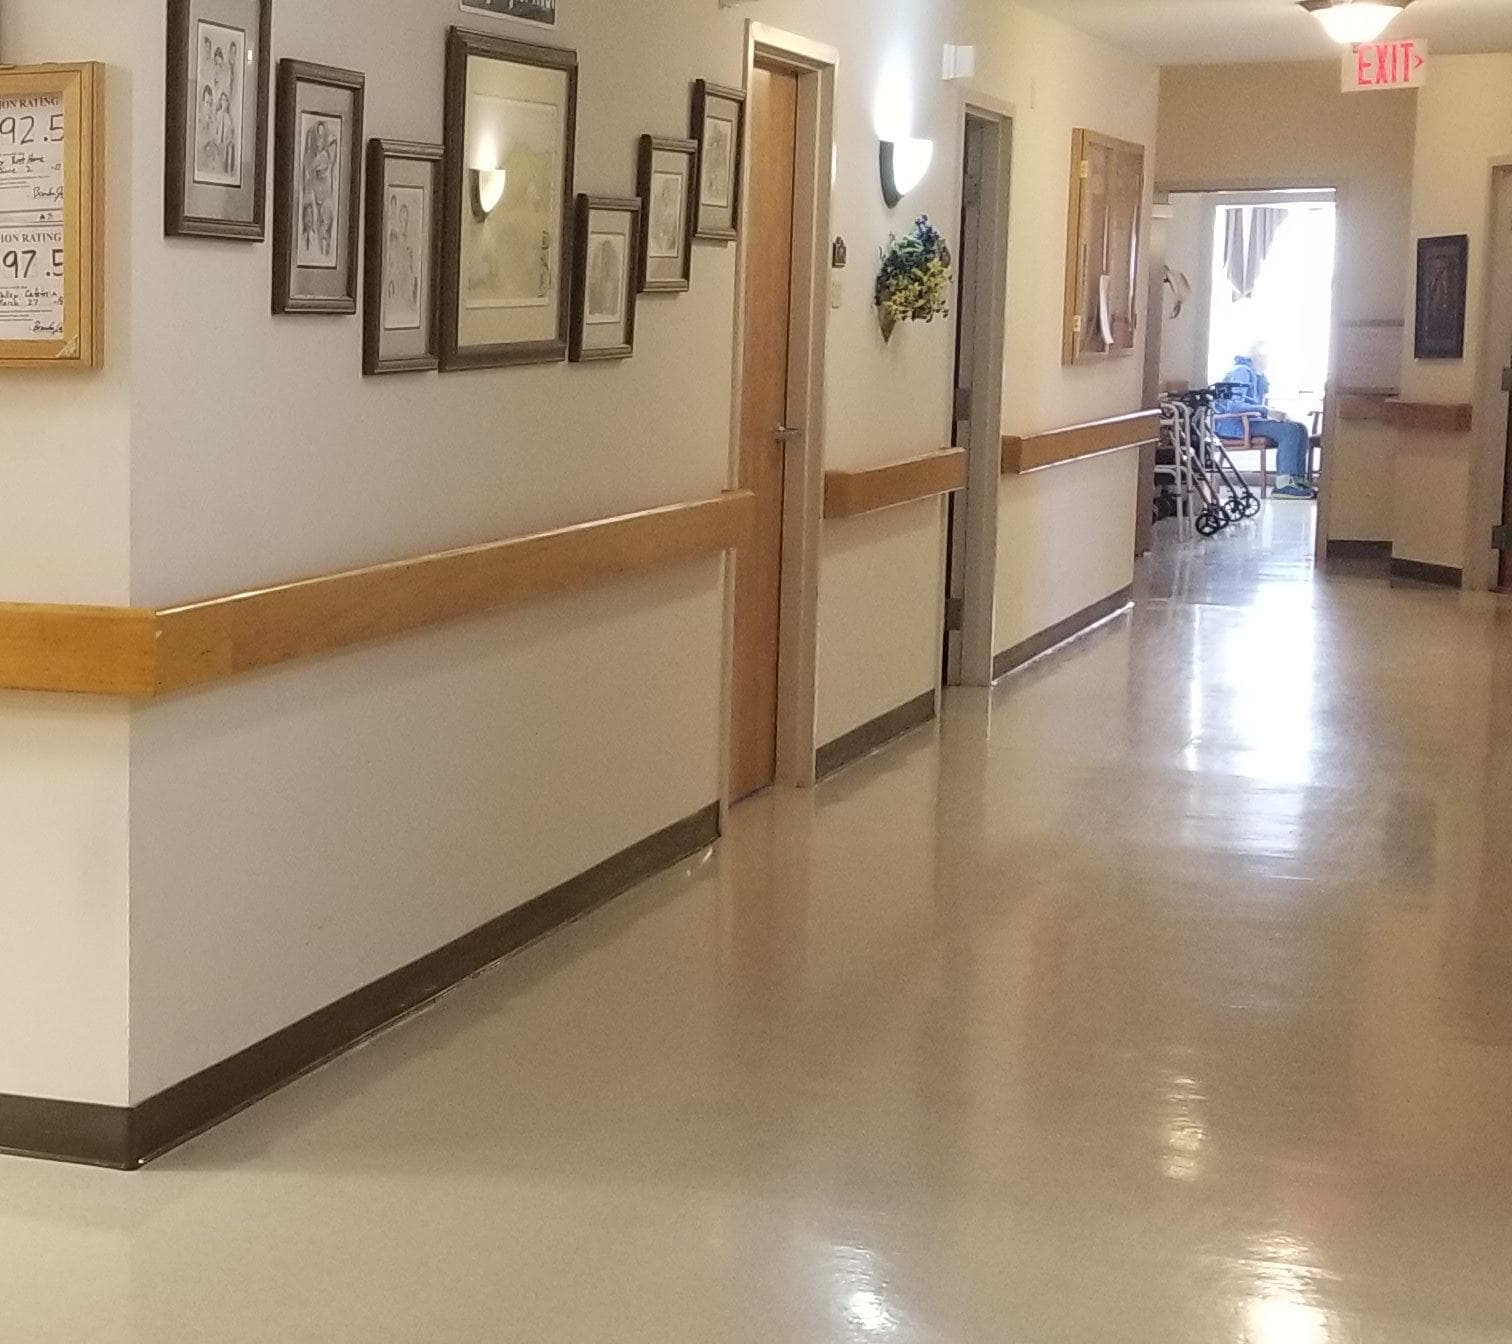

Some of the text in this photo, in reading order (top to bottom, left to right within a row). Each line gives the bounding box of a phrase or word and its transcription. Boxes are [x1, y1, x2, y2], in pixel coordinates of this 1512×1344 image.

[1358, 42, 1414, 86] EXIT
[19, 97, 59, 108] RATING
[22, 232, 61, 243] RATING
